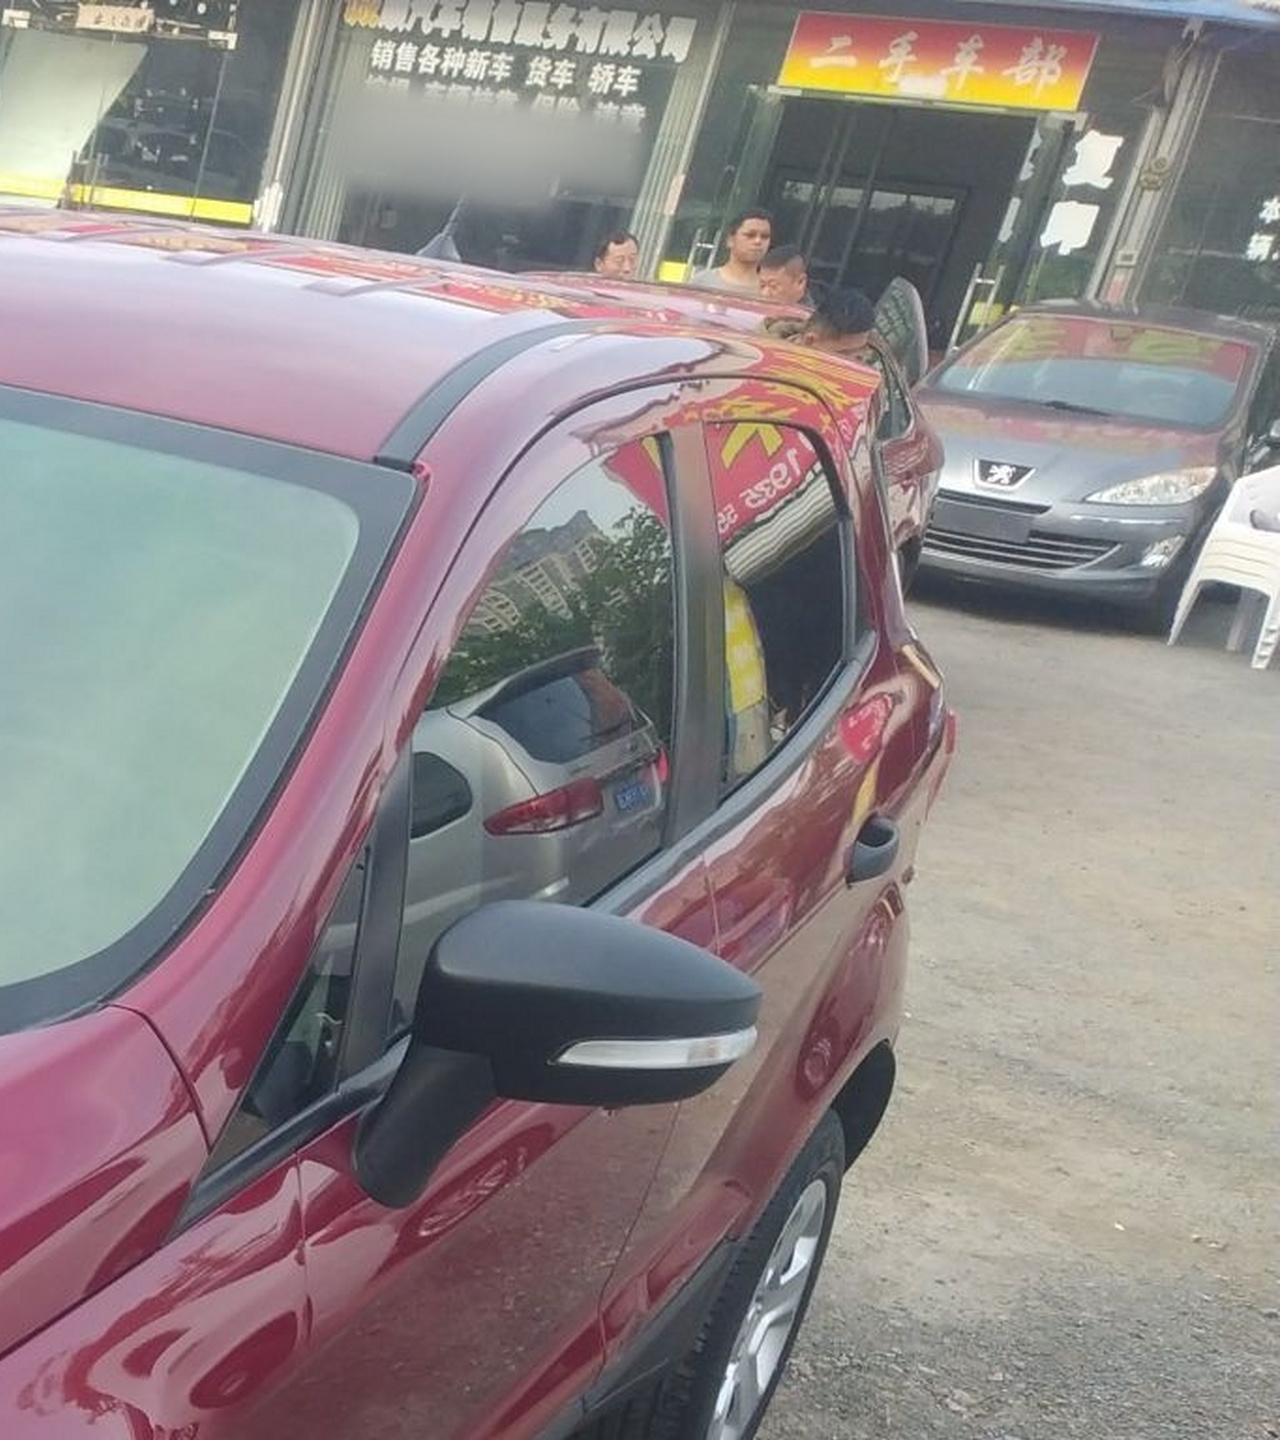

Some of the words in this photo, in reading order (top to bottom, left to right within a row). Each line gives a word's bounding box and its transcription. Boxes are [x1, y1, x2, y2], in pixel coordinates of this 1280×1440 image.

[370, 38, 516, 82] 销售各种新车
[524, 55, 577, 90] 货车
[587, 62, 642, 97] 轿车
